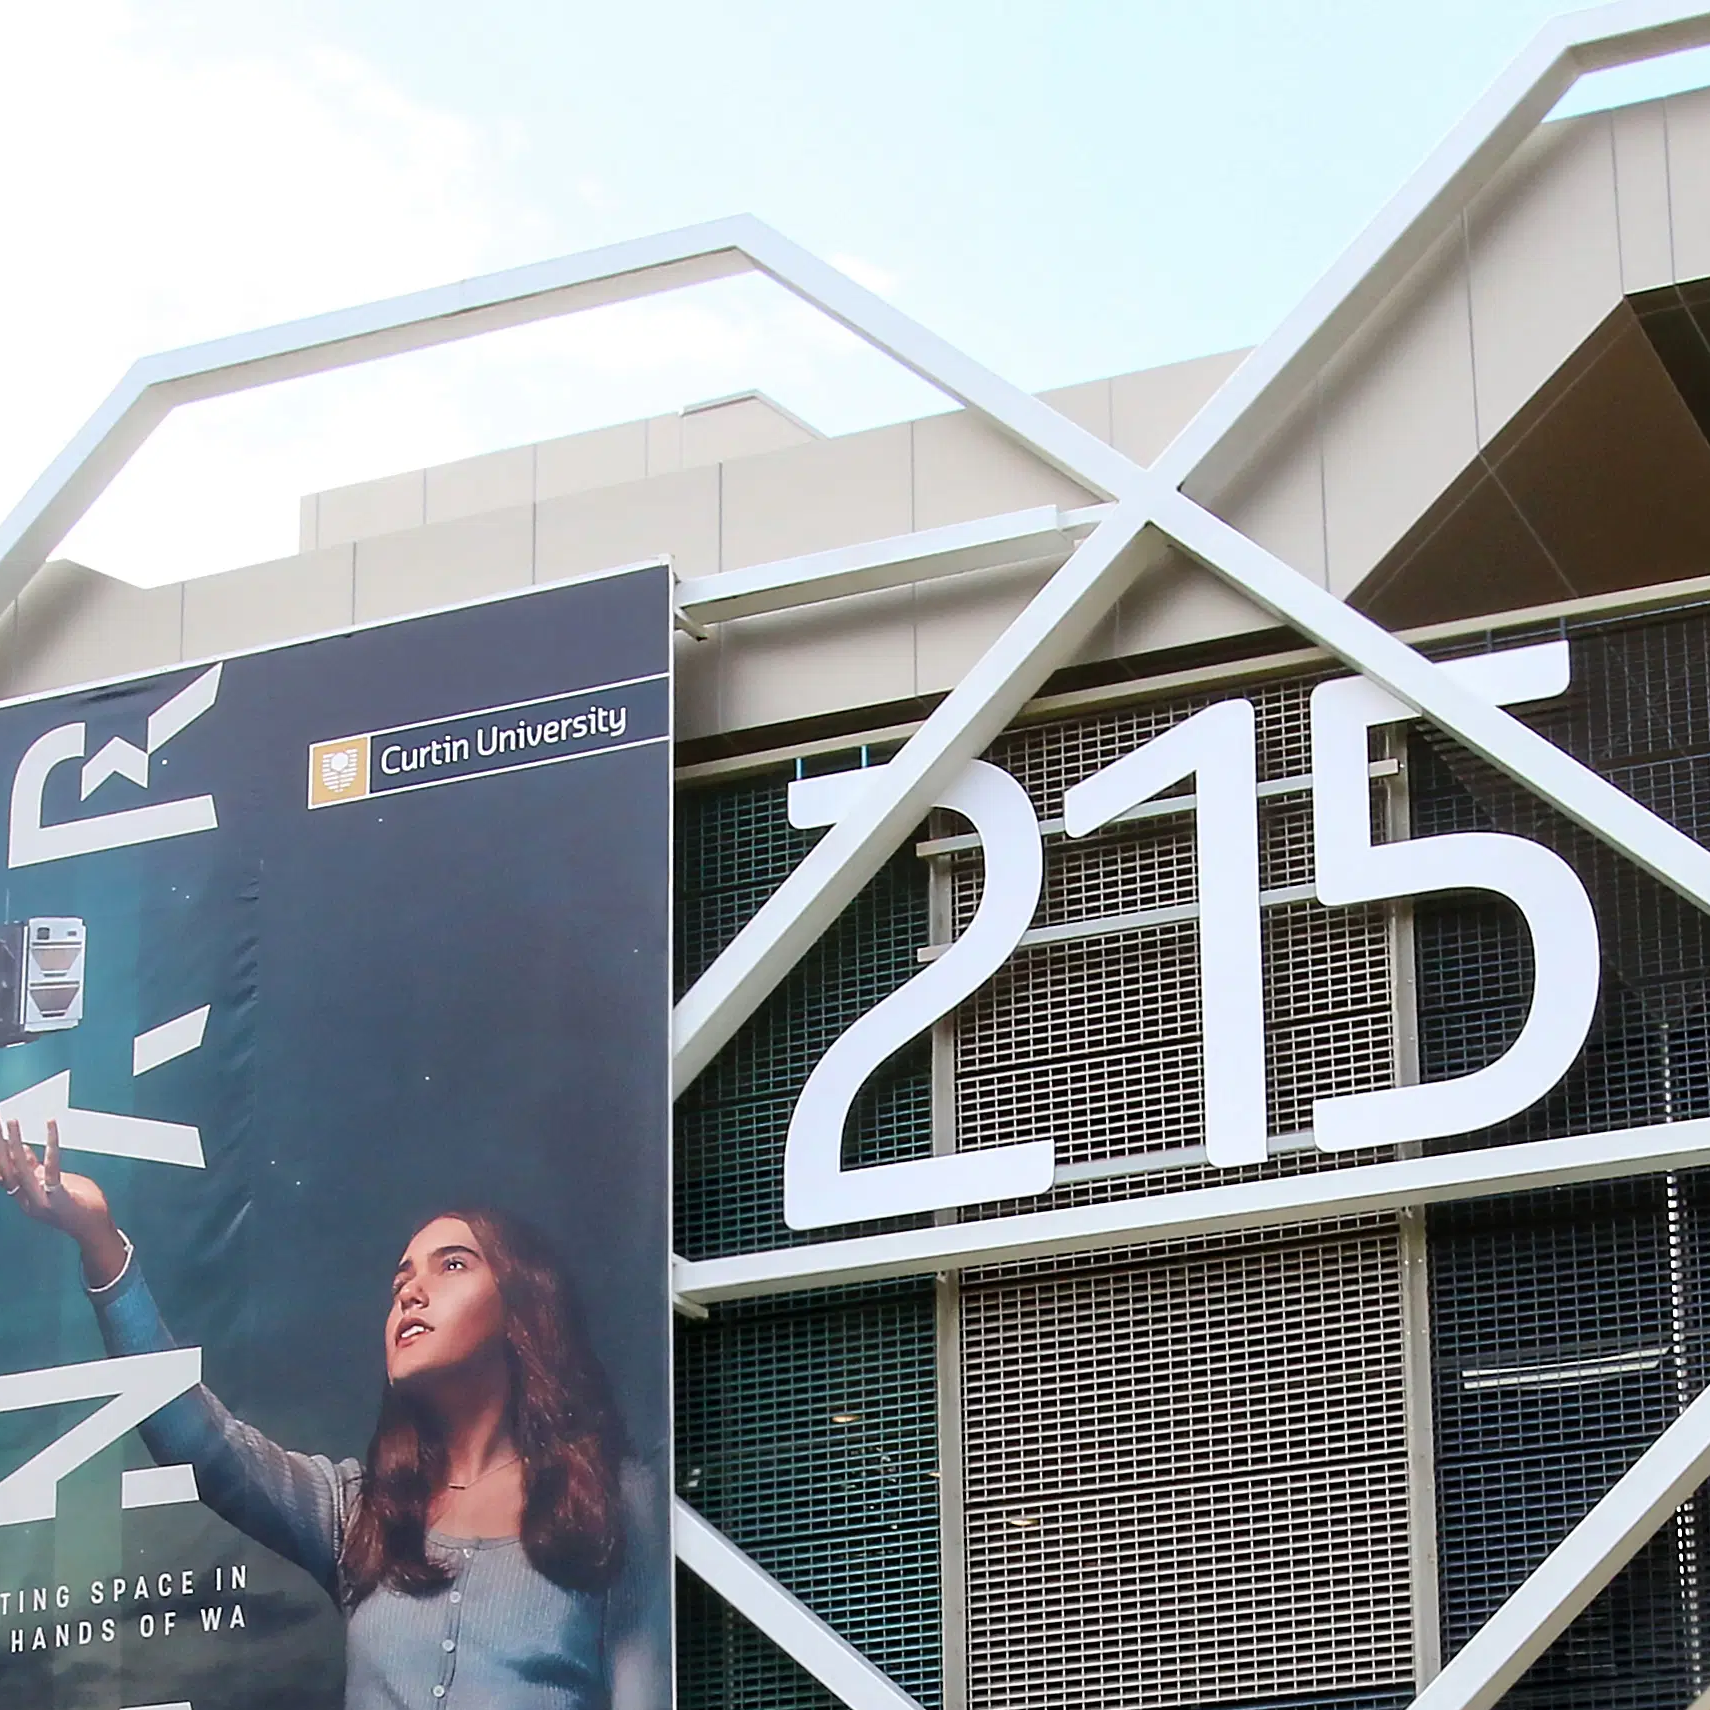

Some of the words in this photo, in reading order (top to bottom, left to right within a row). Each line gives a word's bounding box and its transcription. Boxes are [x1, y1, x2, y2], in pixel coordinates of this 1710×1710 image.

[380, 735, 469, 775] Curtin
[477, 705, 627, 757] University
[782, 638, 1602, 1231] 215
[90, 1570, 194, 1605] SPACE
[216, 1565, 247, 1591] IN
[11, 1618, 116, 1653] HANDS
[140, 1611, 177, 1639] OF
[200, 1604, 246, 1632] WA
